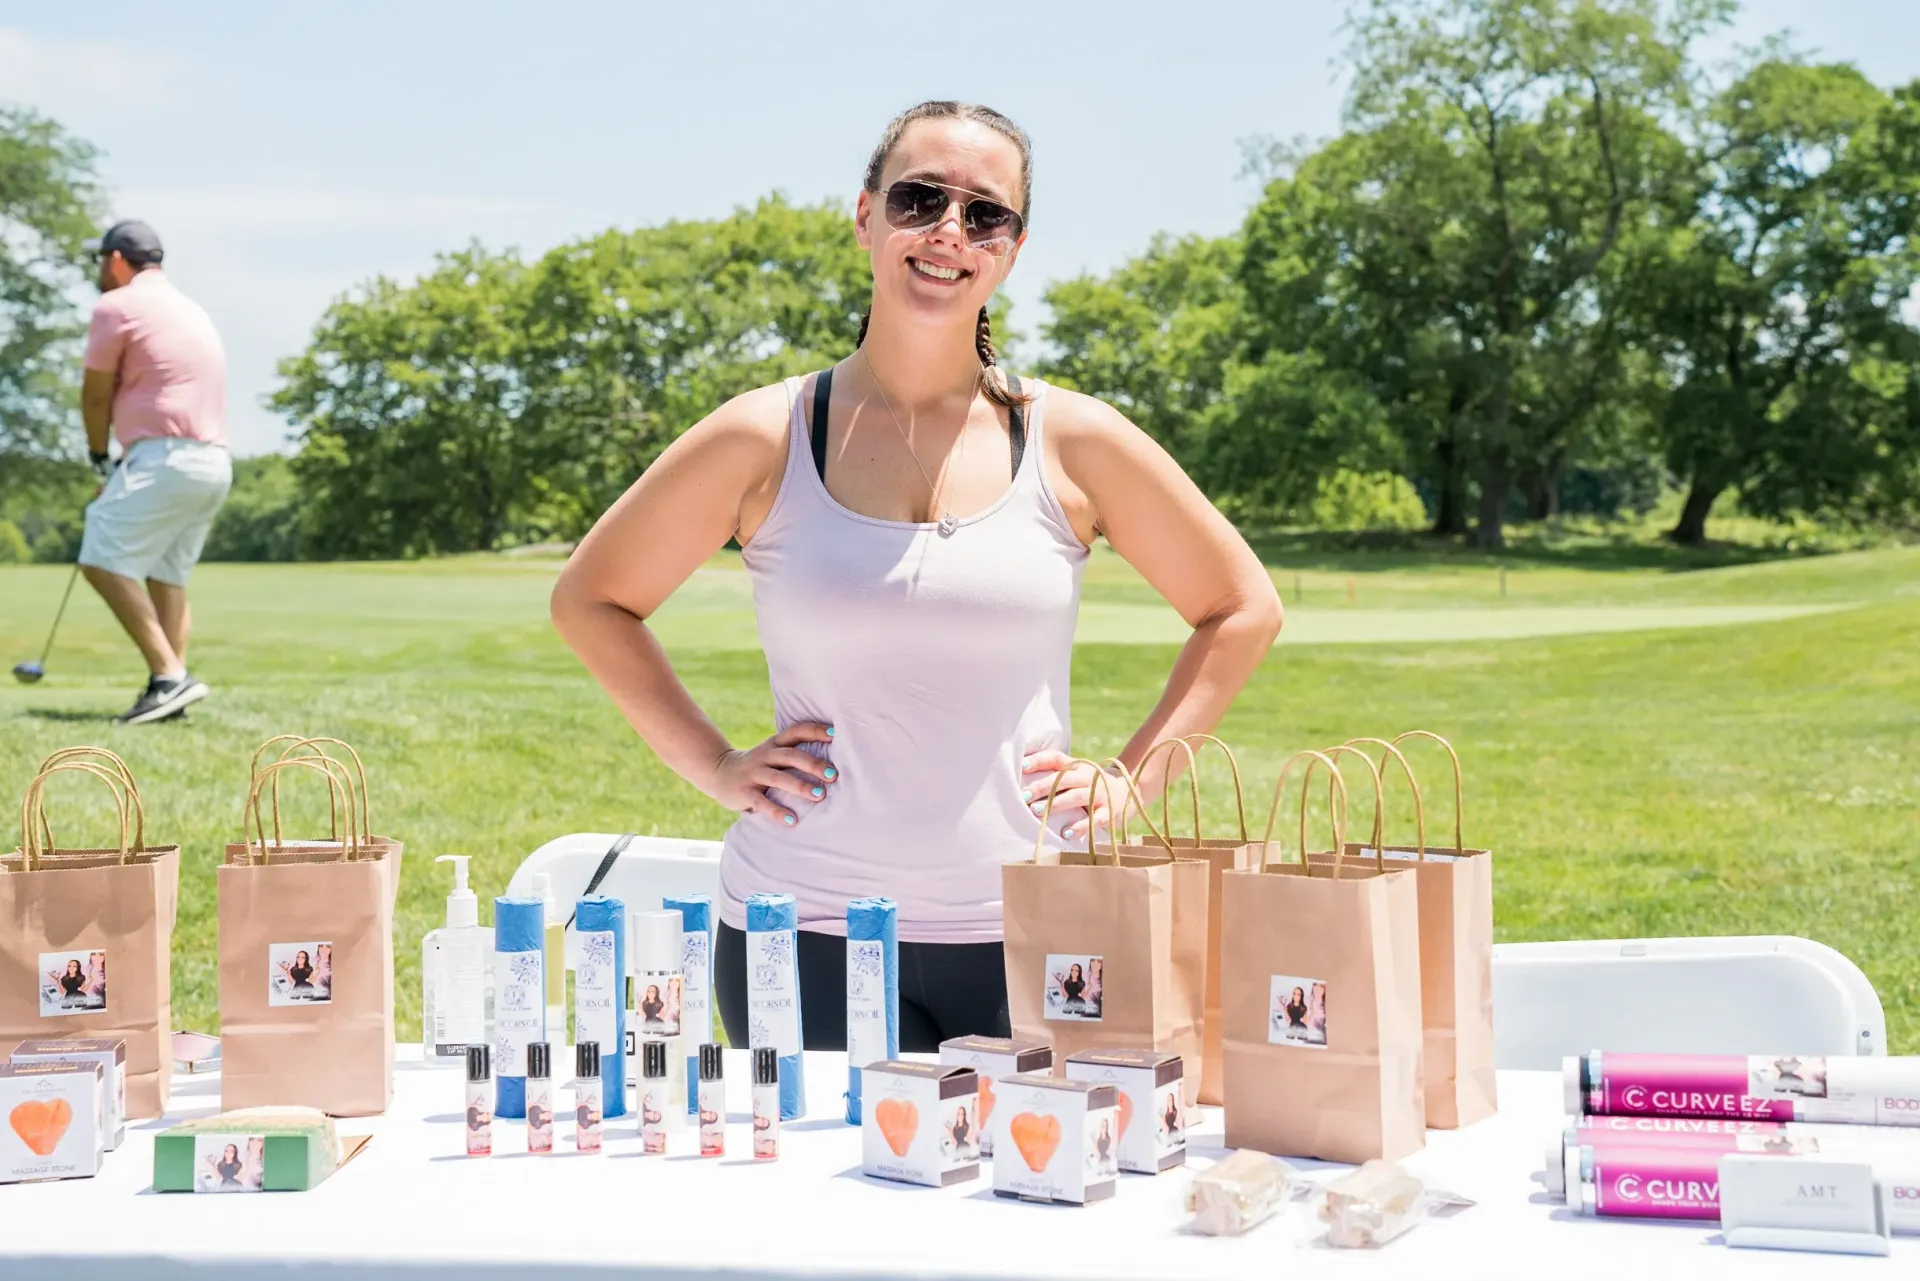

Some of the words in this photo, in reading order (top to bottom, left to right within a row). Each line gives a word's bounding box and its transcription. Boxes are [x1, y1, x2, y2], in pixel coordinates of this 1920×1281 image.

[1652, 1090, 1773, 1114] CURVEEZ
[1884, 1097, 1920, 1111] BOD
[1636, 1118, 1757, 1134] CURVEEZ
[1646, 1179, 1720, 1201] CURV
